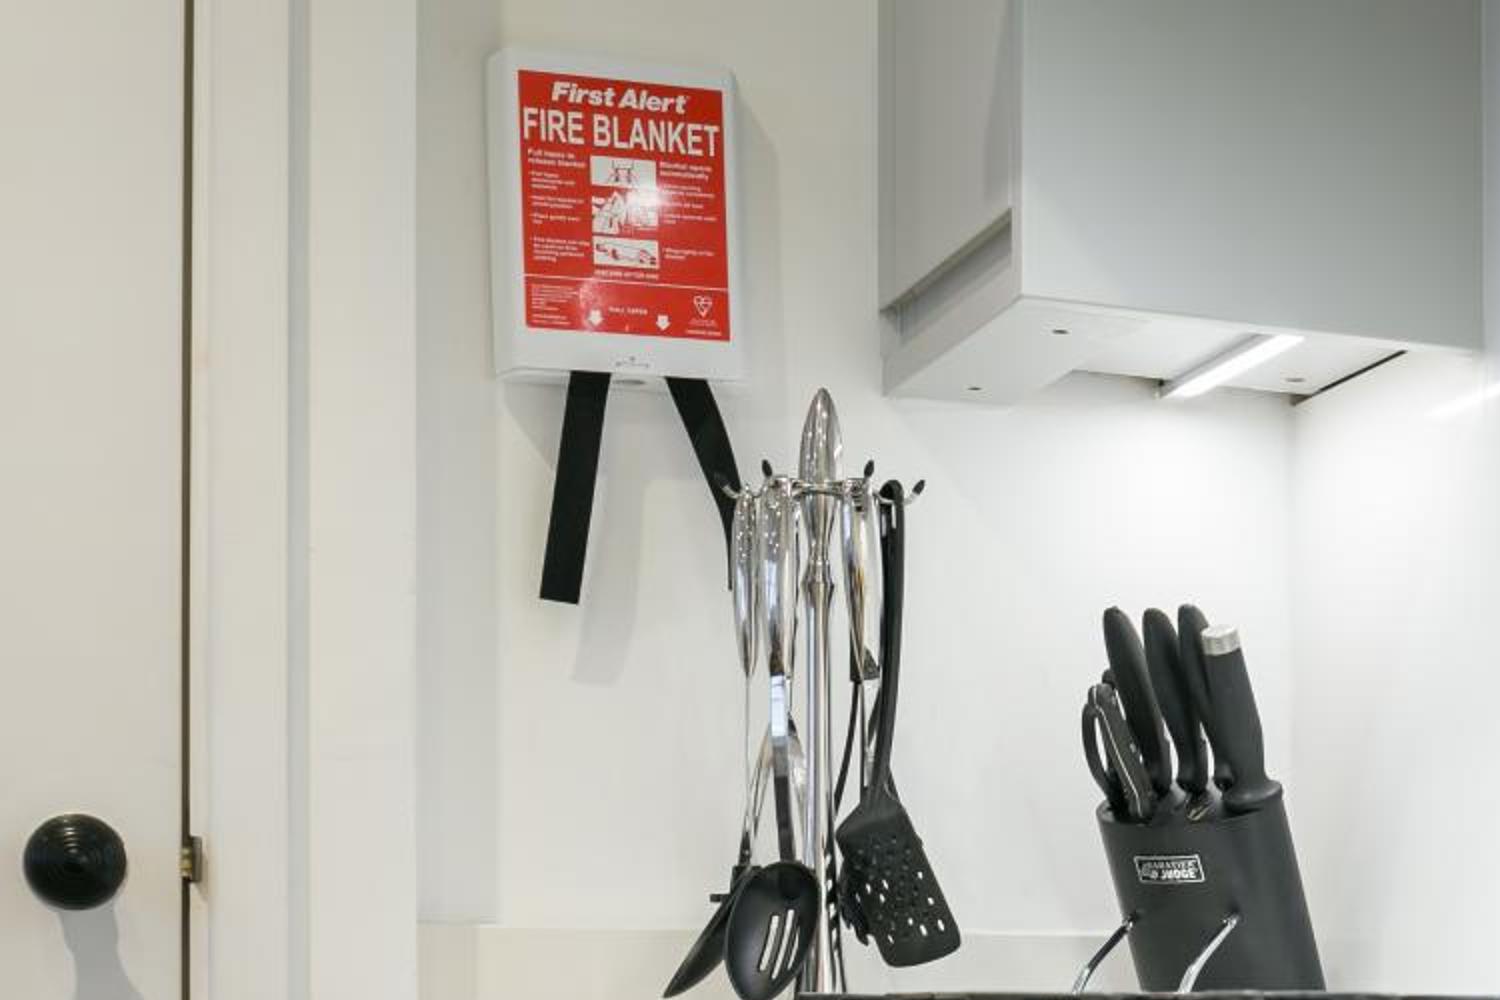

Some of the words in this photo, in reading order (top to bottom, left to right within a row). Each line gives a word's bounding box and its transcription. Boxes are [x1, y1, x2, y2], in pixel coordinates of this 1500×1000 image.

[552, 81, 616, 107] First
[617, 88, 687, 115] Alert
[523, 107, 584, 145] FIRE
[593, 114, 720, 157] BLANKET
[1161, 868, 1197, 879] JUDGE
